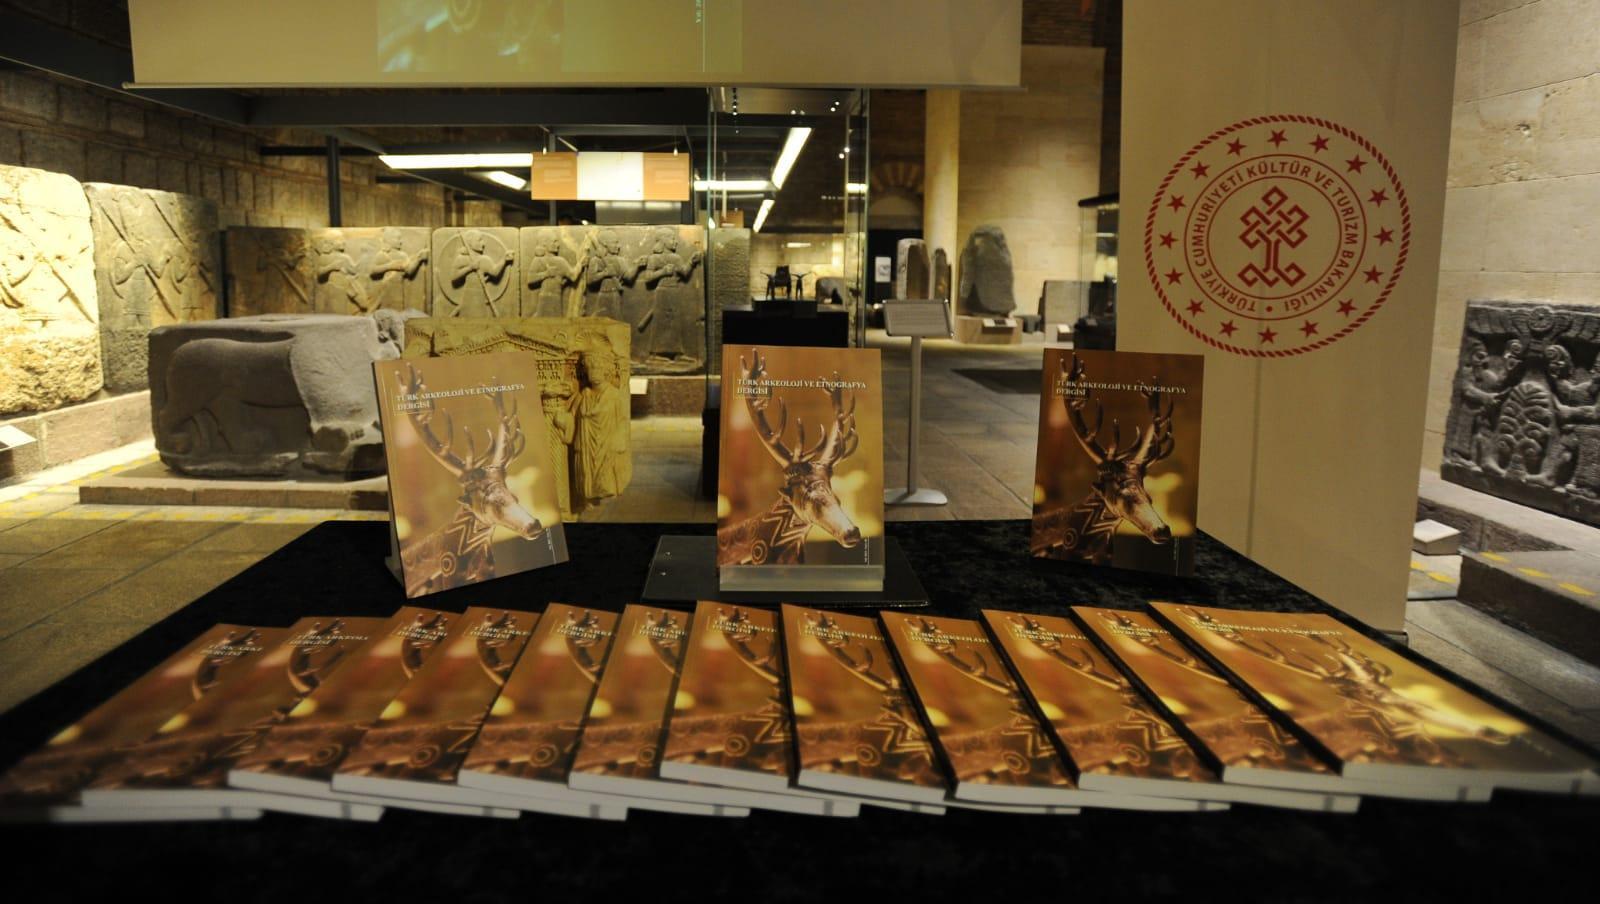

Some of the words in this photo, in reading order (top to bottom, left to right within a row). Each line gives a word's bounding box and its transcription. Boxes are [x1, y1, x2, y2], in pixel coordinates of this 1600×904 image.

[1247, 160, 1311, 179] KÜLTÜR
[1314, 172, 1334, 189] VE
[1192, 171, 1245, 267] CUMHURİYETİ
[1334, 187, 1359, 245] TURİZM
[1283, 249, 1355, 313] BAKANLIĞI
[1200, 268, 1257, 313] TÜRKİYE
[420, 389, 464, 399] ARKEOLOJİ
[464, 387, 476, 395] VE
[476, 383, 525, 394] ETNOGRAFYA
[737, 387, 768, 395] DERGİSİ
[738, 379, 758, 387] TÜRK
[760, 380, 803, 388] ARKEOLOJİ
[816, 381, 866, 389] ETNOGRAFYA
[1056, 388, 1086, 396] DERGİSİ
[1134, 385, 1186, 394] ETNOGRAFYA
